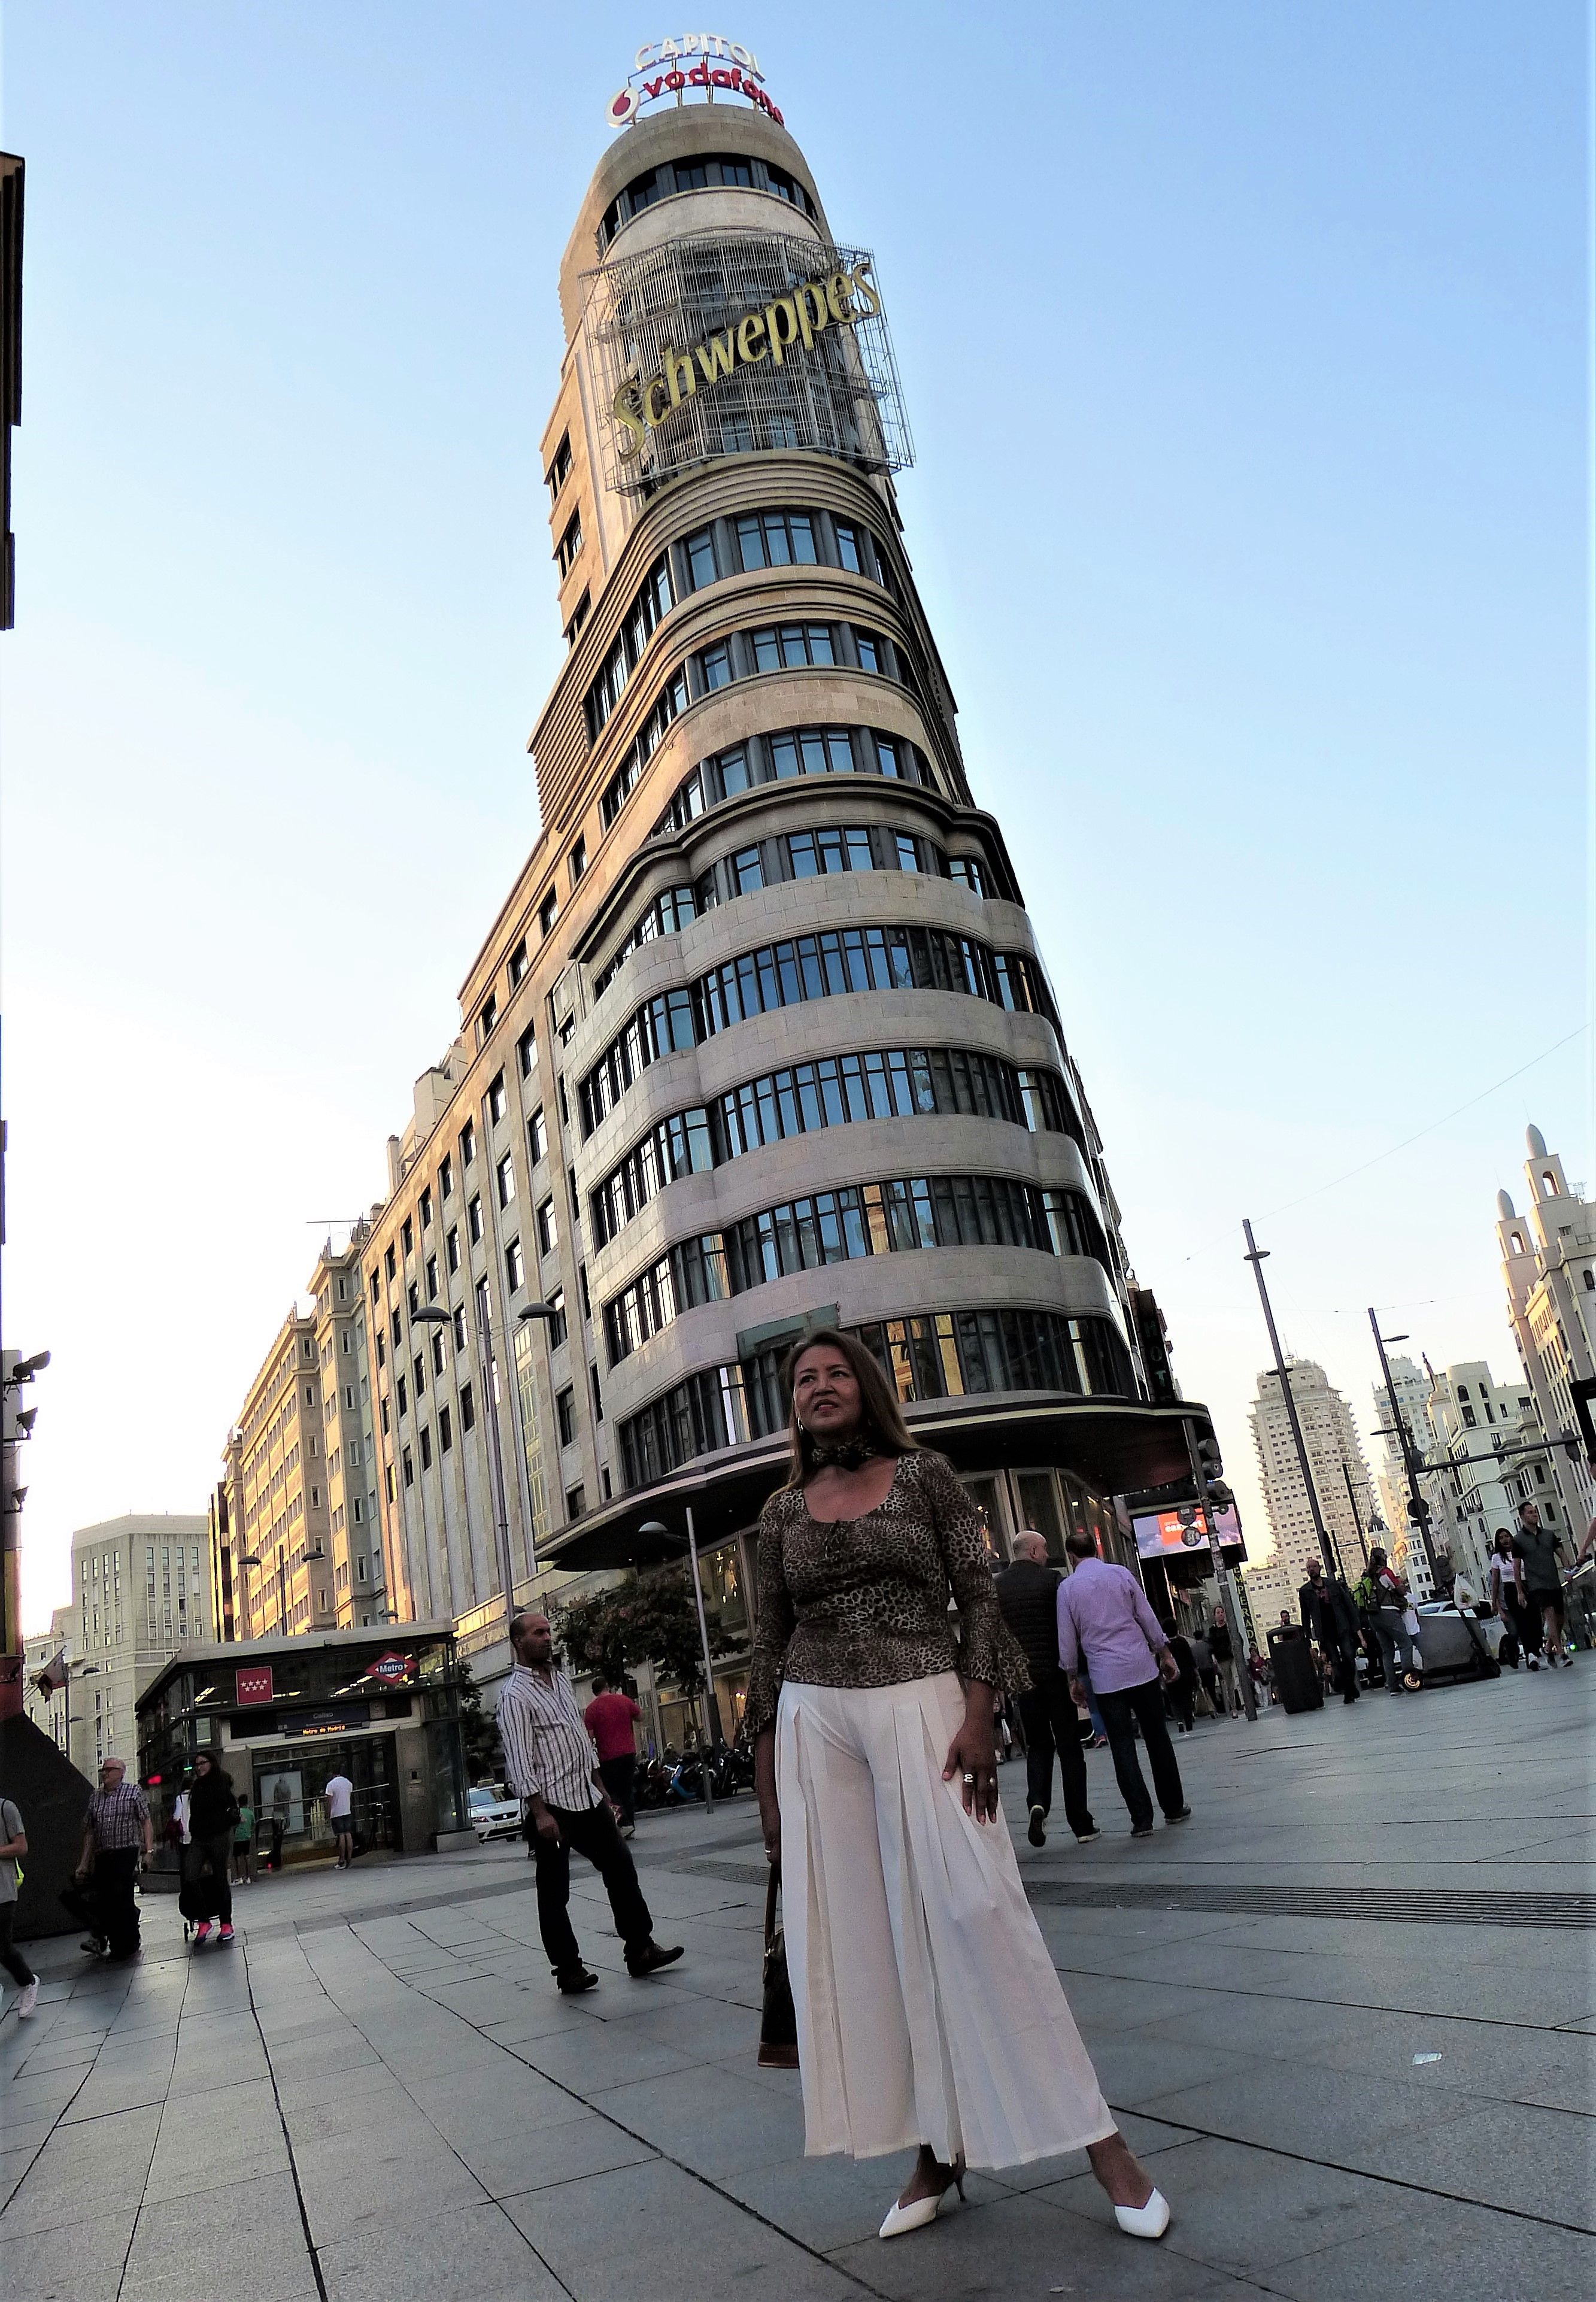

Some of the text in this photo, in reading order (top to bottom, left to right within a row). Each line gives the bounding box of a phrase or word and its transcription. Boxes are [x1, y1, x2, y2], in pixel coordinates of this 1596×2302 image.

[635, 32, 766, 83] CAPITOL
[613, 262, 880, 464] Schweppes
[380, 1664, 403, 1673] Metro
